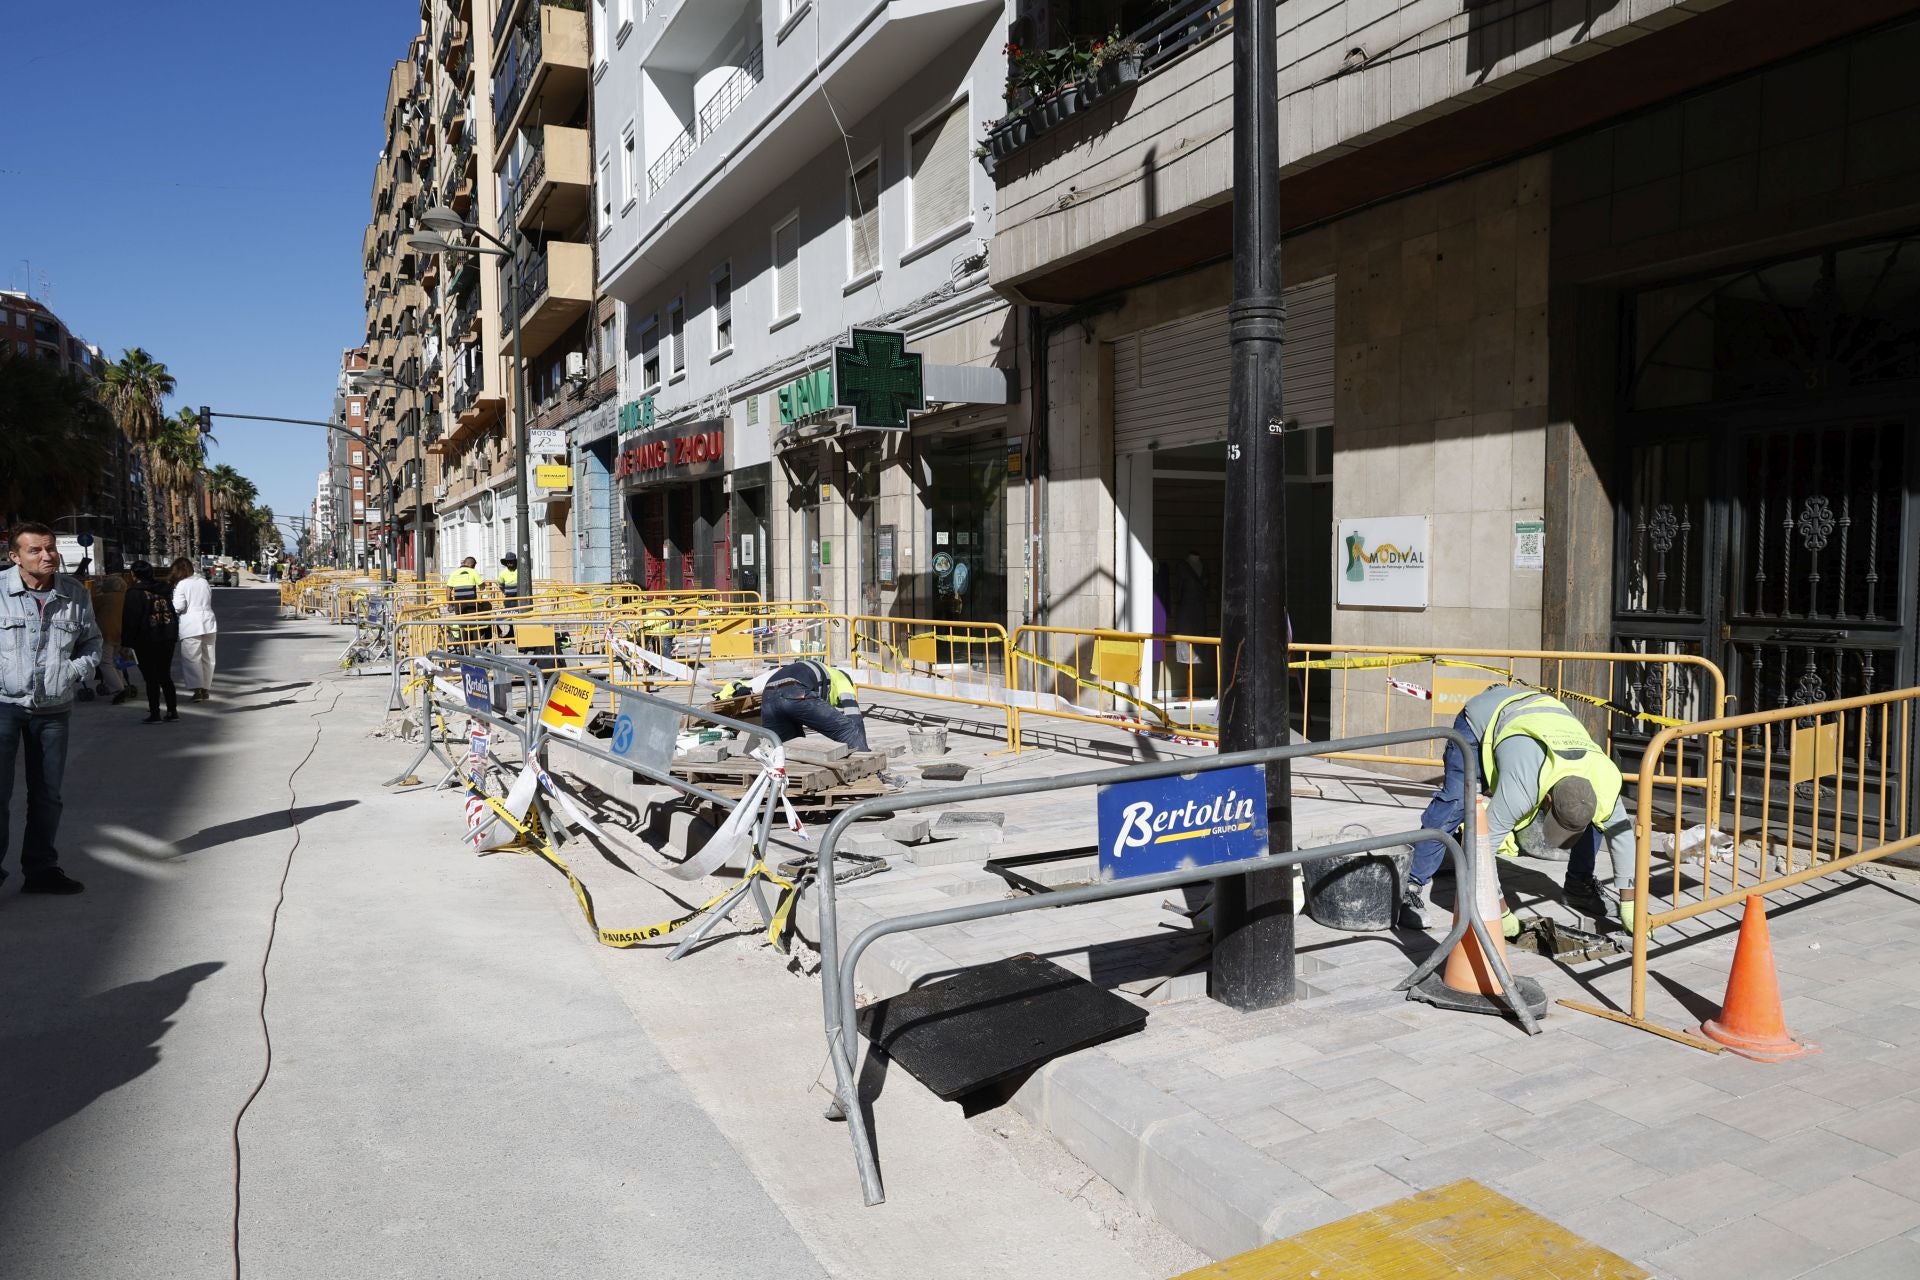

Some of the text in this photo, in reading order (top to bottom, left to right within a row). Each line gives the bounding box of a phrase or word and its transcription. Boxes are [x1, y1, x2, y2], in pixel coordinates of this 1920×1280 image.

[635, 440, 668, 472] HANG
[673, 431, 724, 465] ZHOU
[1369, 550, 1424, 564] MODIVAL
[564, 682, 590, 700] PEATONES
[1113, 790, 1255, 858] Bertolín
[1212, 824, 1237, 835] GRUPO
[603, 931, 648, 943] PAVASAL
